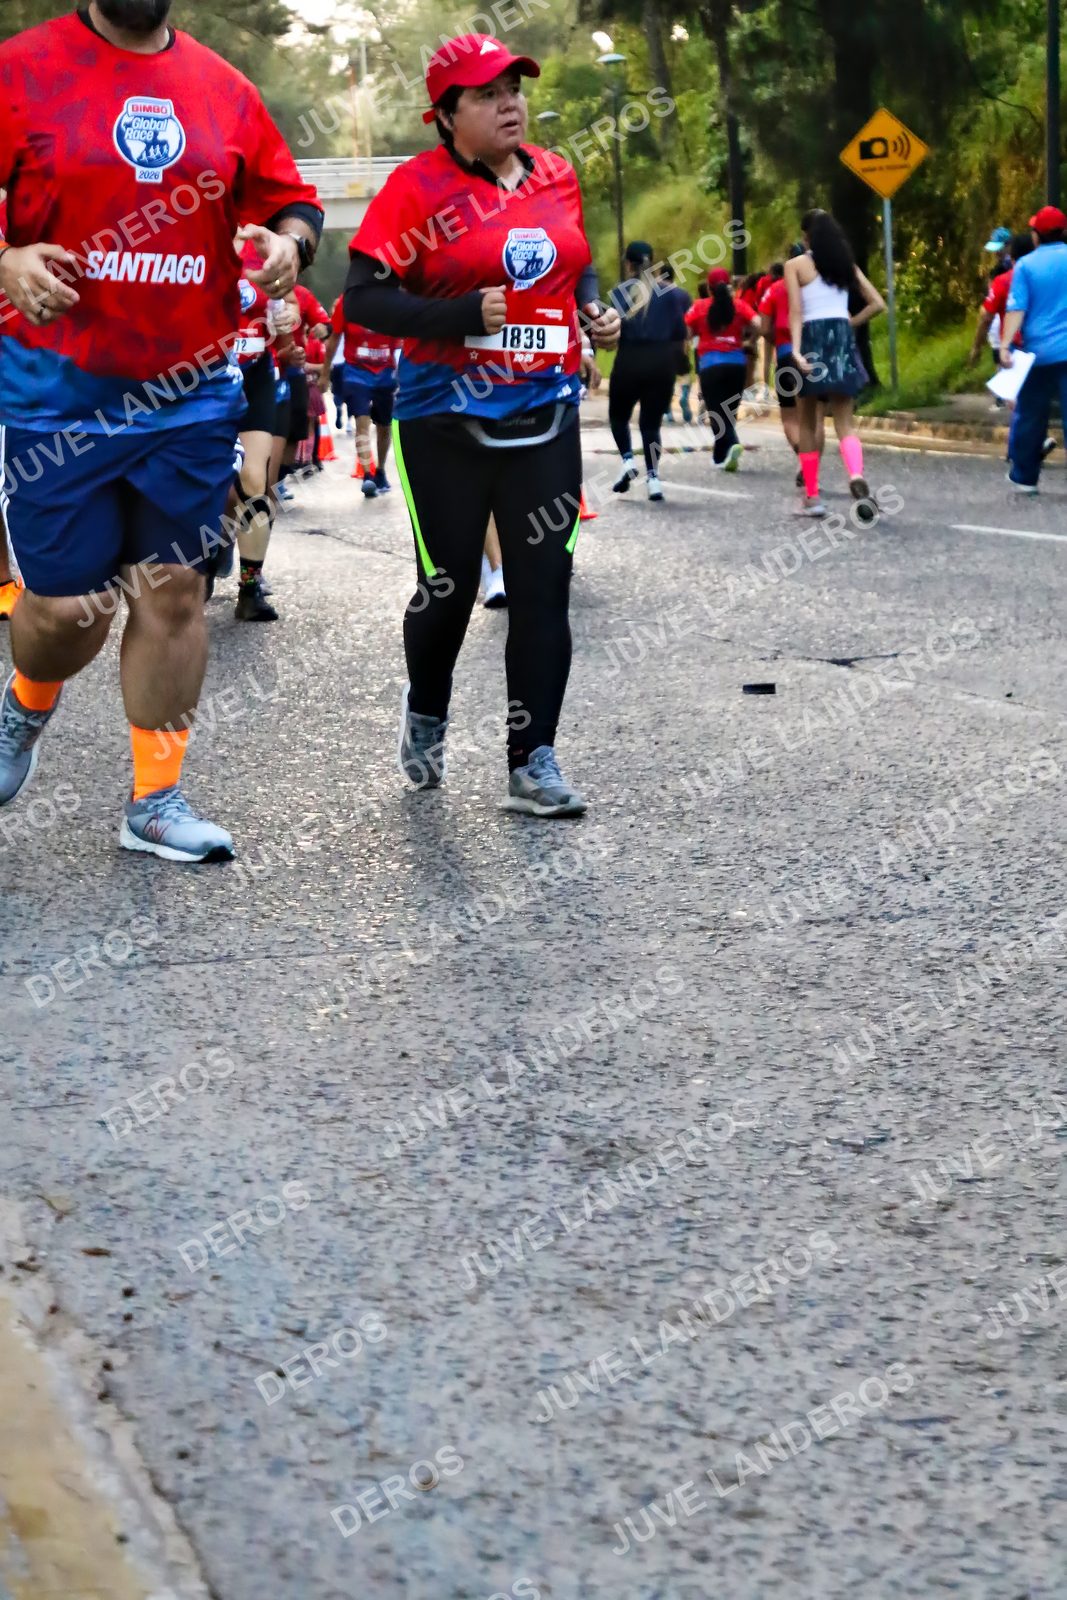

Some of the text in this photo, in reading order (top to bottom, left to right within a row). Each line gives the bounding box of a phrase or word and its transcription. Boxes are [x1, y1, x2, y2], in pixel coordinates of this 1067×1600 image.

[131, 104, 168, 115] BIMBO
[131, 116, 168, 131] Global
[124, 127, 154, 141] Race
[516, 241, 544, 252] Global
[511, 250, 534, 260] Race
[85, 250, 206, 285] SANTIAGO
[502, 326, 546, 350] 1839
